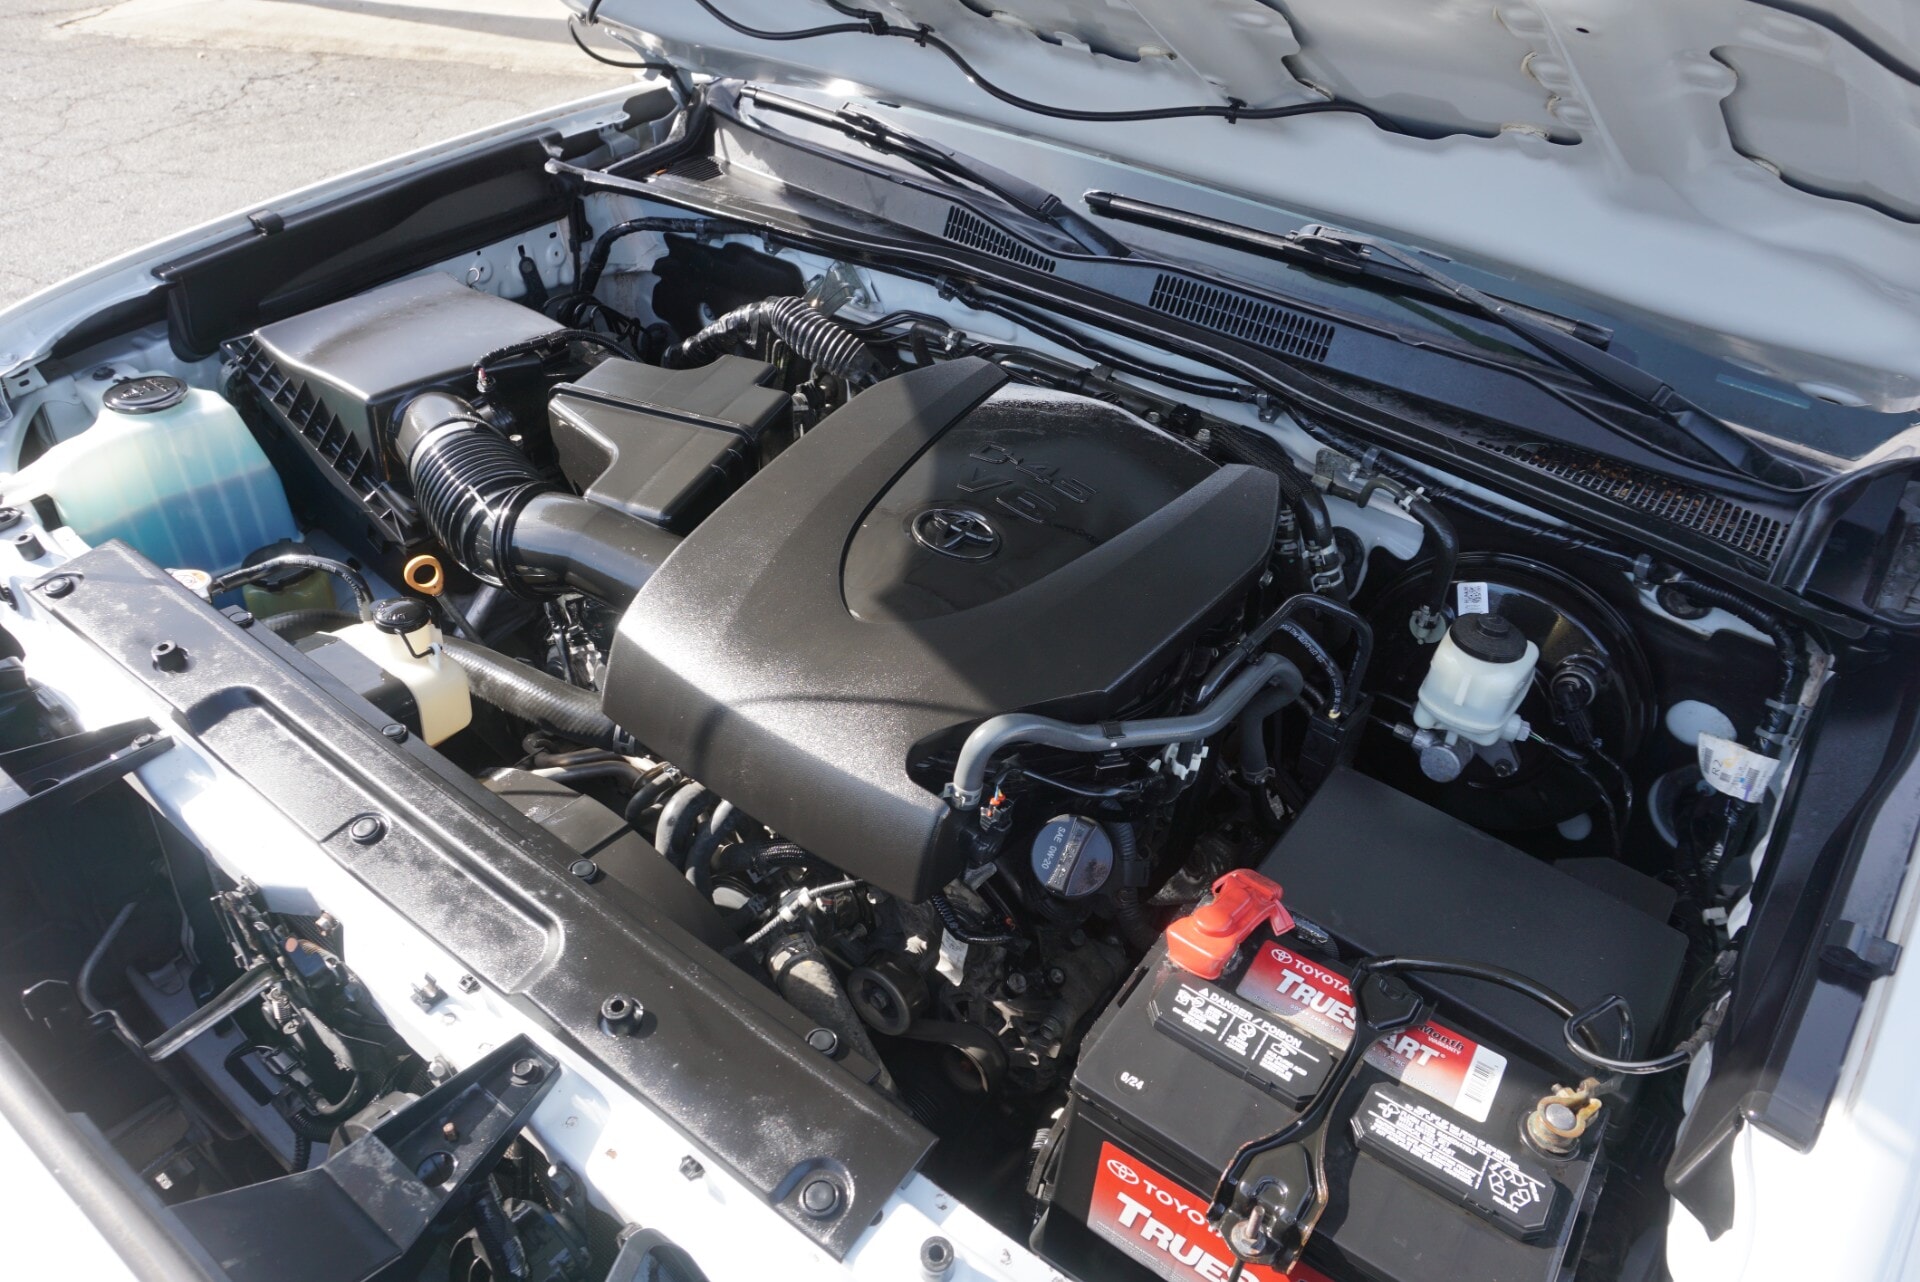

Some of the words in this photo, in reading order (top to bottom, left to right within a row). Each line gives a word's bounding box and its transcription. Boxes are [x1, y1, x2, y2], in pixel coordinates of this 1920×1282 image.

[1053, 826, 1066, 843] SAE
[1041, 845, 1058, 870] 0W-20
[1295, 959, 1353, 996] TOYOTA
[1210, 991, 1254, 1022] DANGER
[1261, 1020, 1302, 1049] POISON
[1419, 1025, 1465, 1051] Month
[1120, 1071, 1144, 1090] 6/24
[1143, 1180, 1223, 1238] TOYO
